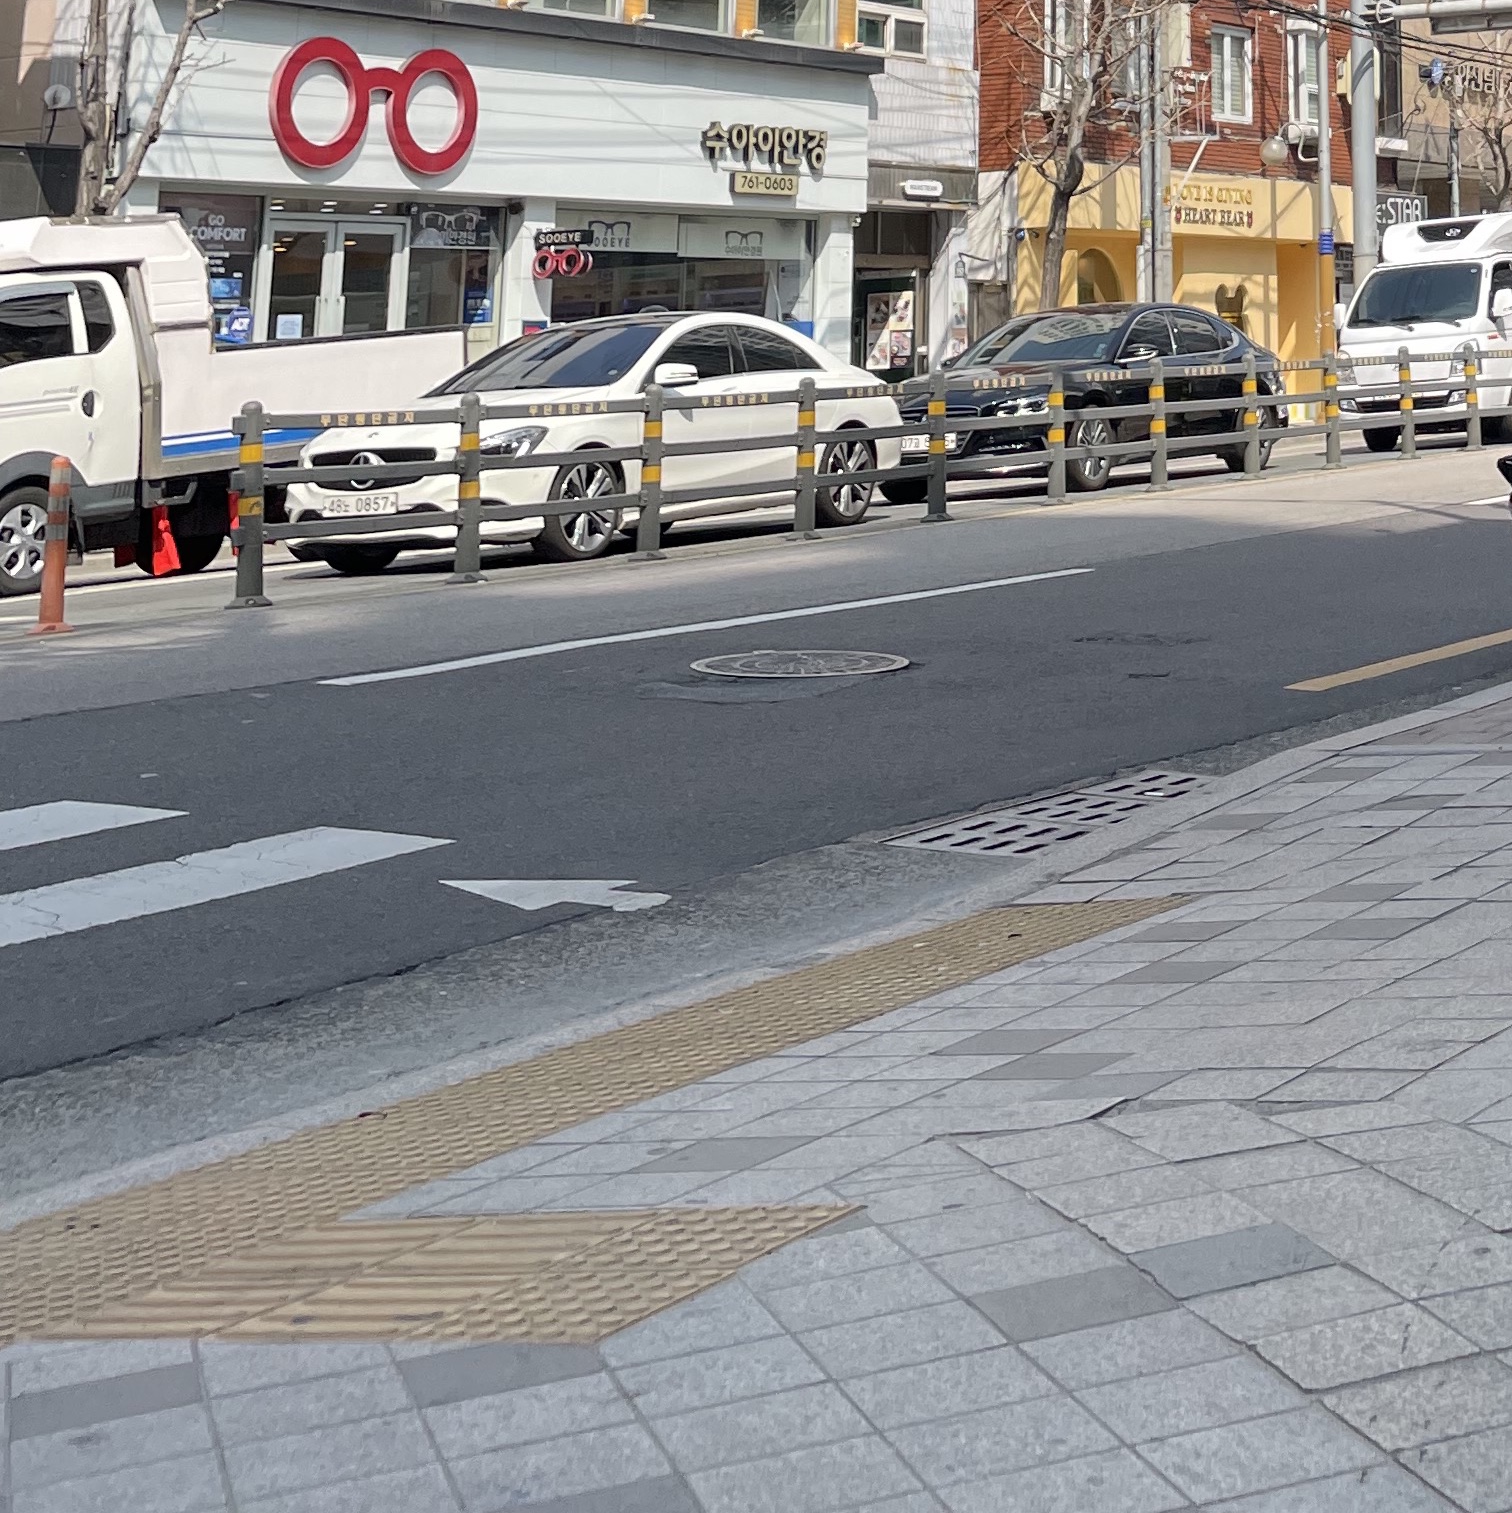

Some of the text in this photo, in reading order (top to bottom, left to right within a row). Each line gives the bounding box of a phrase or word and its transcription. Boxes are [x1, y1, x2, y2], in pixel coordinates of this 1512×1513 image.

[703, 121, 828, 170] 수아이안경
[740, 175, 794, 191] 761-0603
[207, 214, 225, 226] GO
[1183, 207, 1245, 227] HEART BEAR
[190, 226, 247, 242] COMFORT
[538, 231, 582, 245] SOOEYE
[355, 496, 390, 513] 0857
